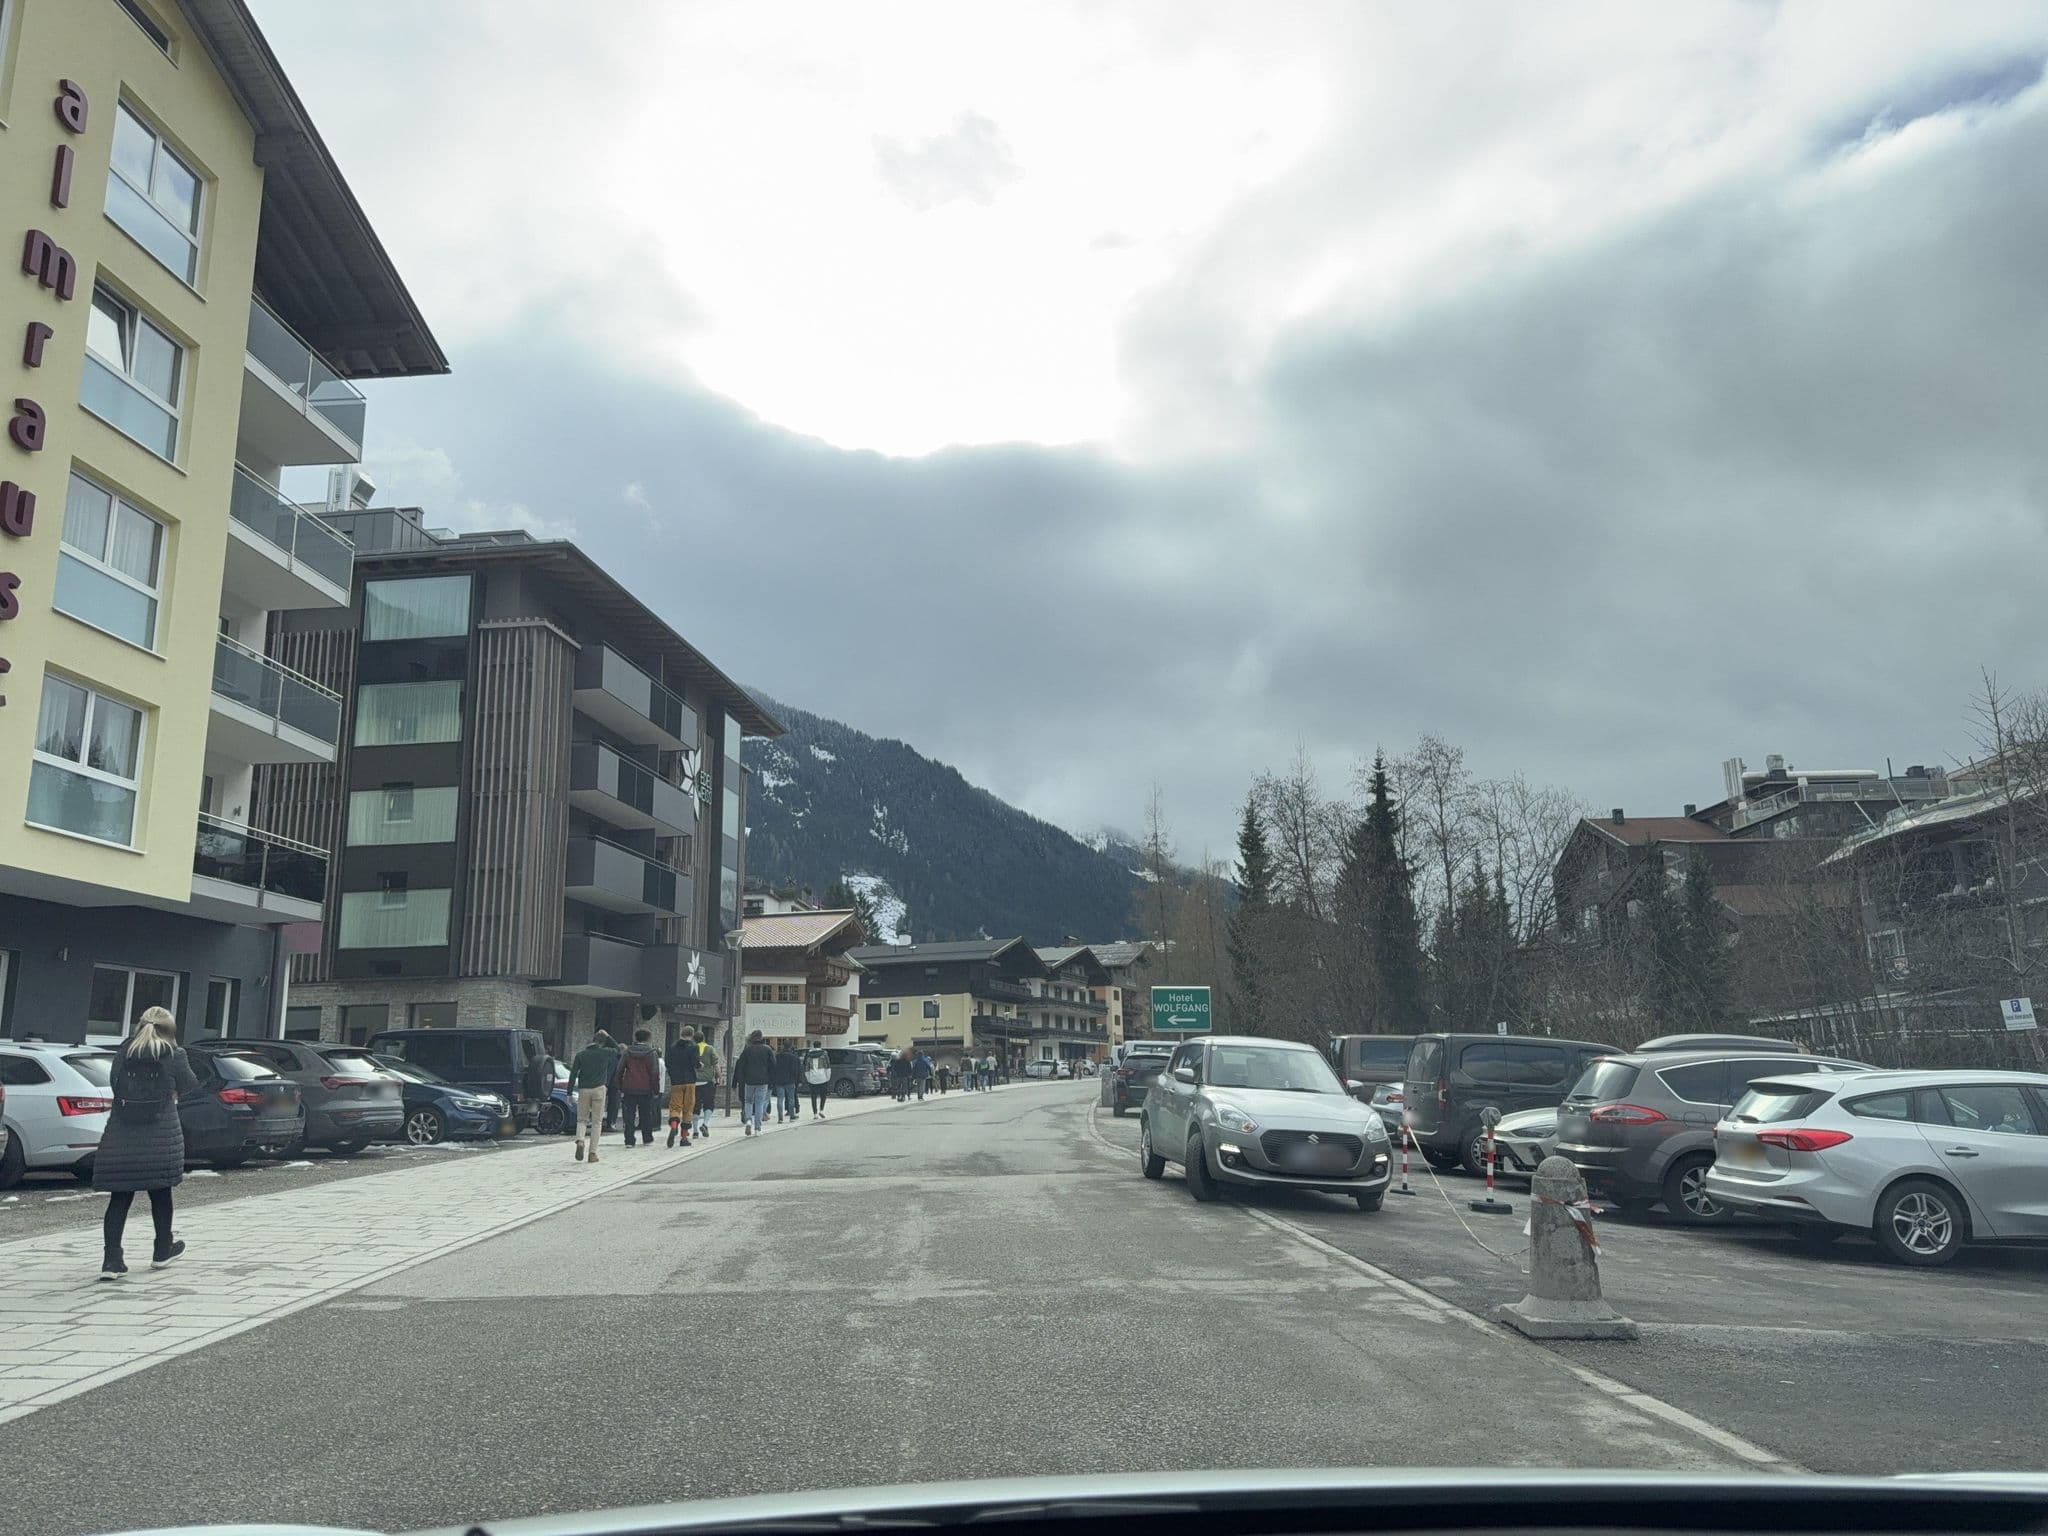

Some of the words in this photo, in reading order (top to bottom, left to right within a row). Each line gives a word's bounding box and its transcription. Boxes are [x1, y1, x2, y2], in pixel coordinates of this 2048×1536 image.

[0, 78, 89, 707] almraus
[1168, 993, 1194, 1002] Hotel
[1153, 1003, 1209, 1013] WOLFGANG
